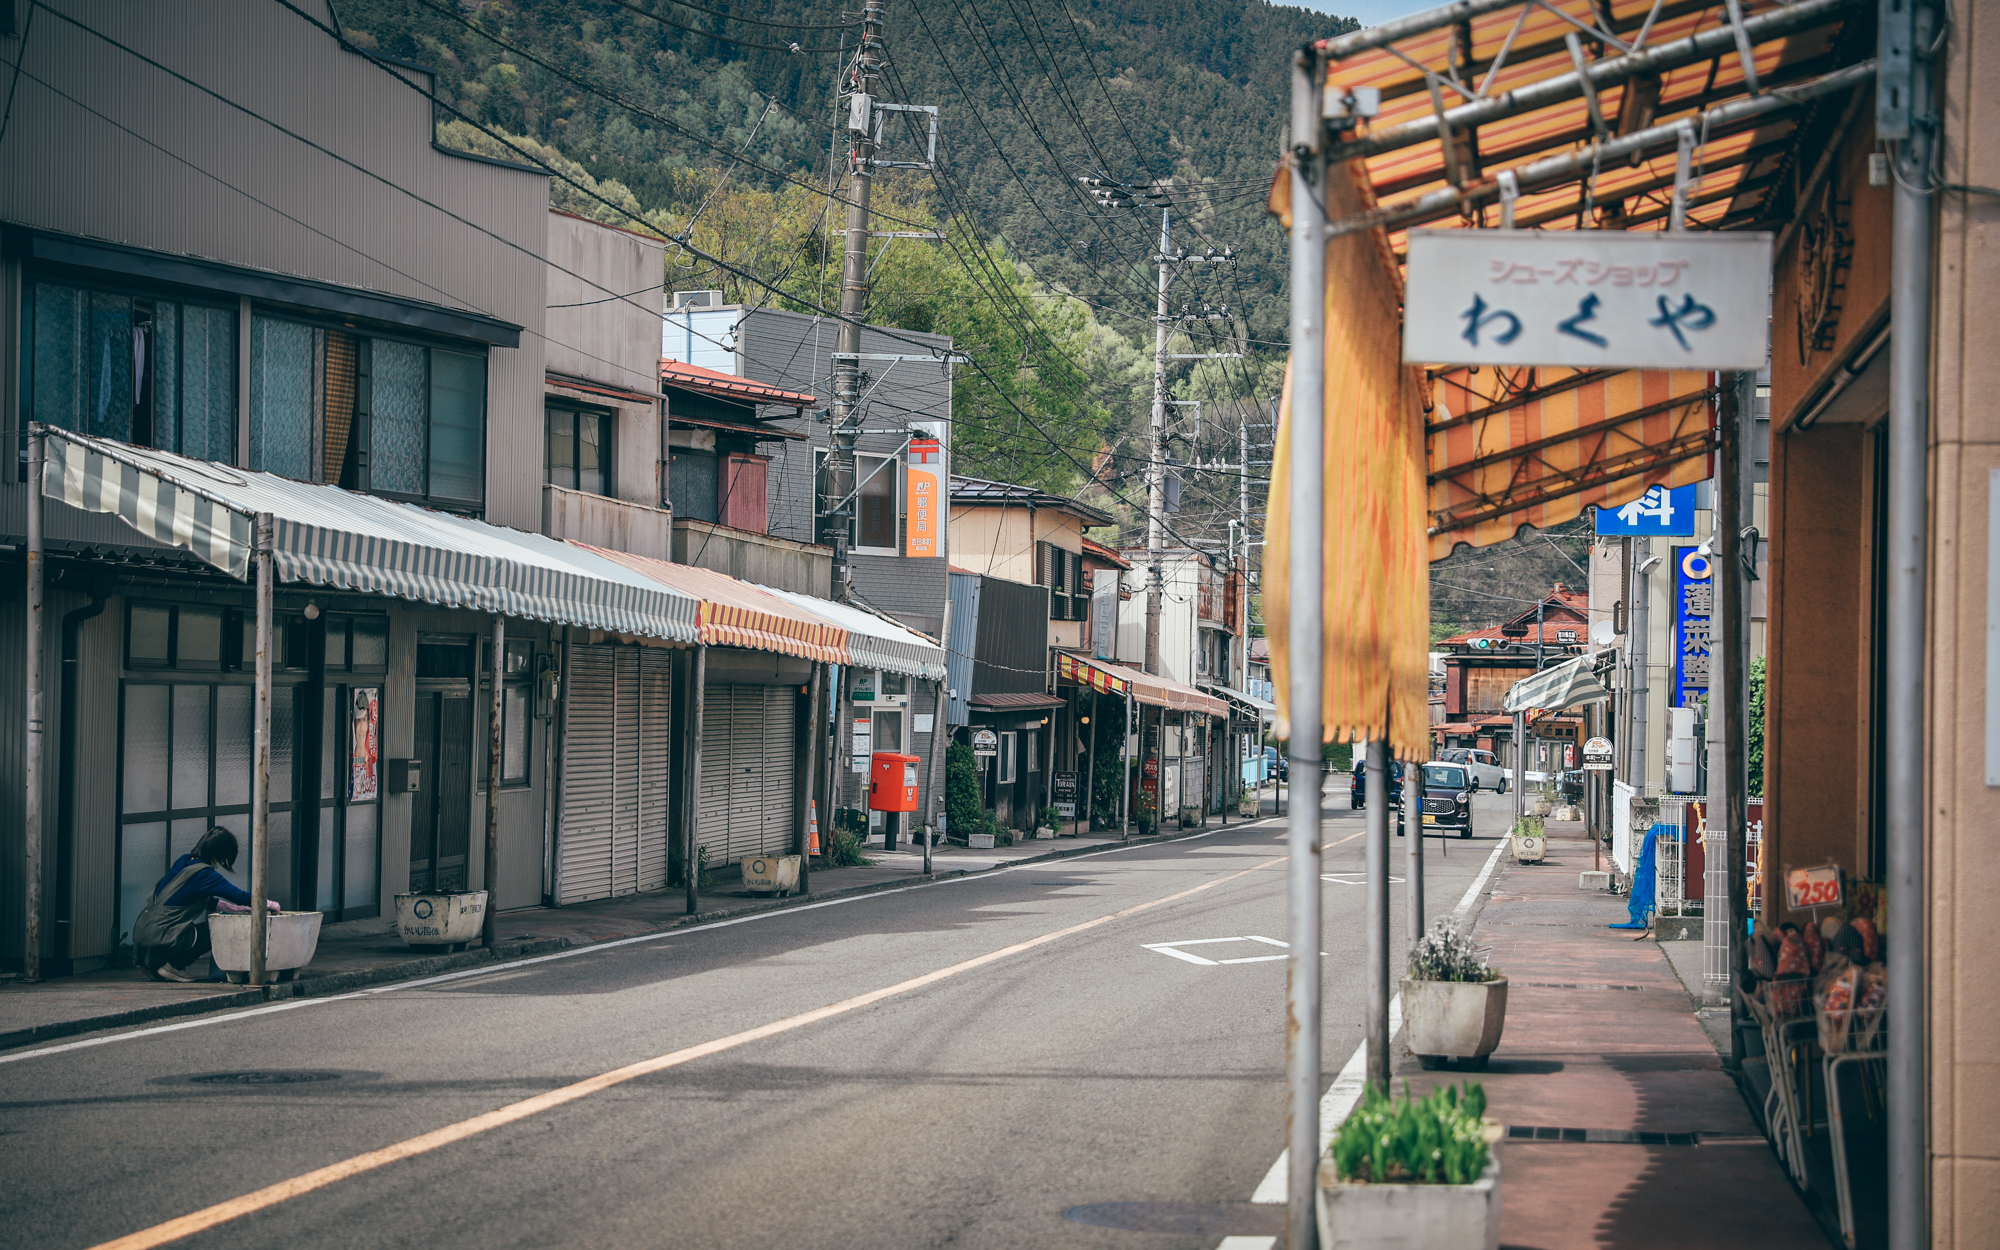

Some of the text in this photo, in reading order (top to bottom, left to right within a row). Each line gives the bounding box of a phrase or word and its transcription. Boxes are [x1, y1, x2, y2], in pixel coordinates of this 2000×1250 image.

[1490, 258, 1689, 287] シューズショップ
[1458, 292, 1717, 351] わくや
[916, 482, 931, 492] JP
[916, 496, 928, 533] 郵便局
